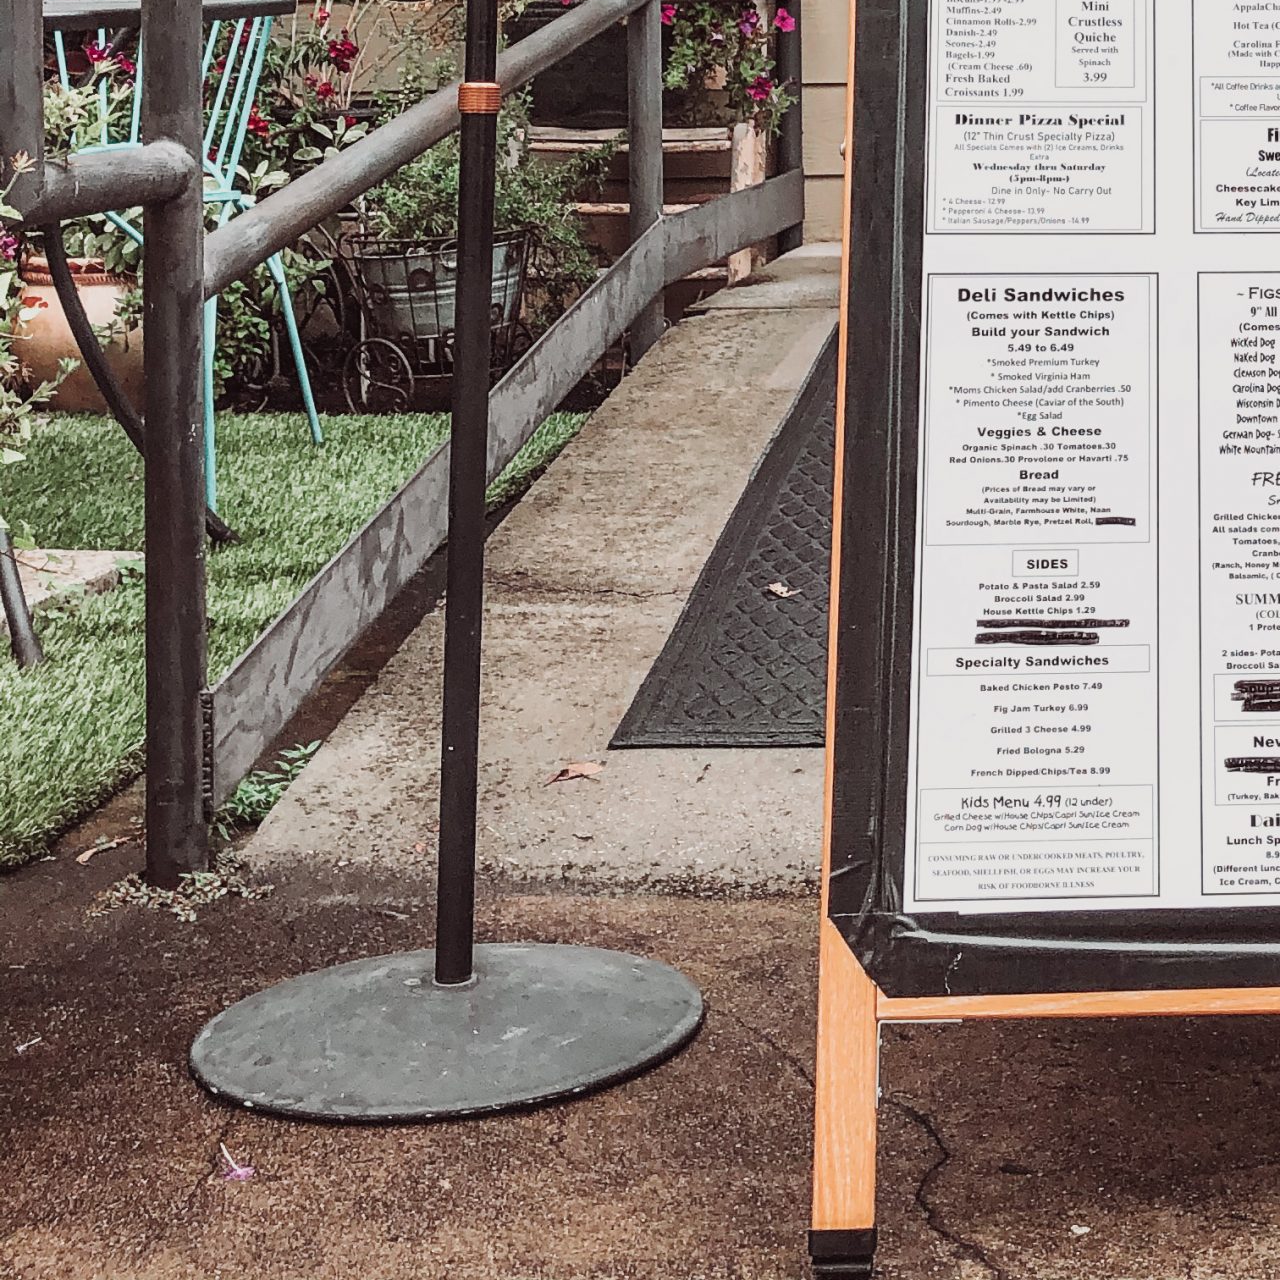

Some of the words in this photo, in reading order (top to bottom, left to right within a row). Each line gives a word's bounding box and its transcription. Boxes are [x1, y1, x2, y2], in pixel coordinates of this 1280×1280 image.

[1081, 0, 1109, 12] Mini
[1067, 16, 1123, 27] Crustless
[1073, 31, 1117, 45] Quiche
[945, 73, 975, 84] Fresh
[978, 73, 1011, 84] Baked
[1082, 72, 1108, 83] 3.99
[944, 86, 1000, 97] Croissants
[1003, 87, 1024, 98] 1.99
[955, 113, 1013, 126] Dinner
[1019, 114, 1063, 126] Pizza
[1068, 113, 1125, 130] Special
[1235, 198, 1257, 209] Key
[957, 287, 997, 303] Deli
[1003, 287, 1125, 303] Sandwiches
[971, 326, 1007, 337] Build
[1010, 328, 1041, 340] your
[1044, 326, 1110, 337] Sandwich
[976, 426, 1032, 440] Veggies
[1036, 426, 1047, 437] &
[1051, 425, 1102, 437] Cheese
[1019, 469, 1059, 480] Bread
[1026, 558, 1069, 570] SIDES
[955, 656, 1021, 671] Specialty
[1025, 655, 1110, 667] Sandwiches
[961, 795, 990, 810] Kids
[992, 795, 1030, 810] Menu
[1033, 794, 1062, 809] 4.99
